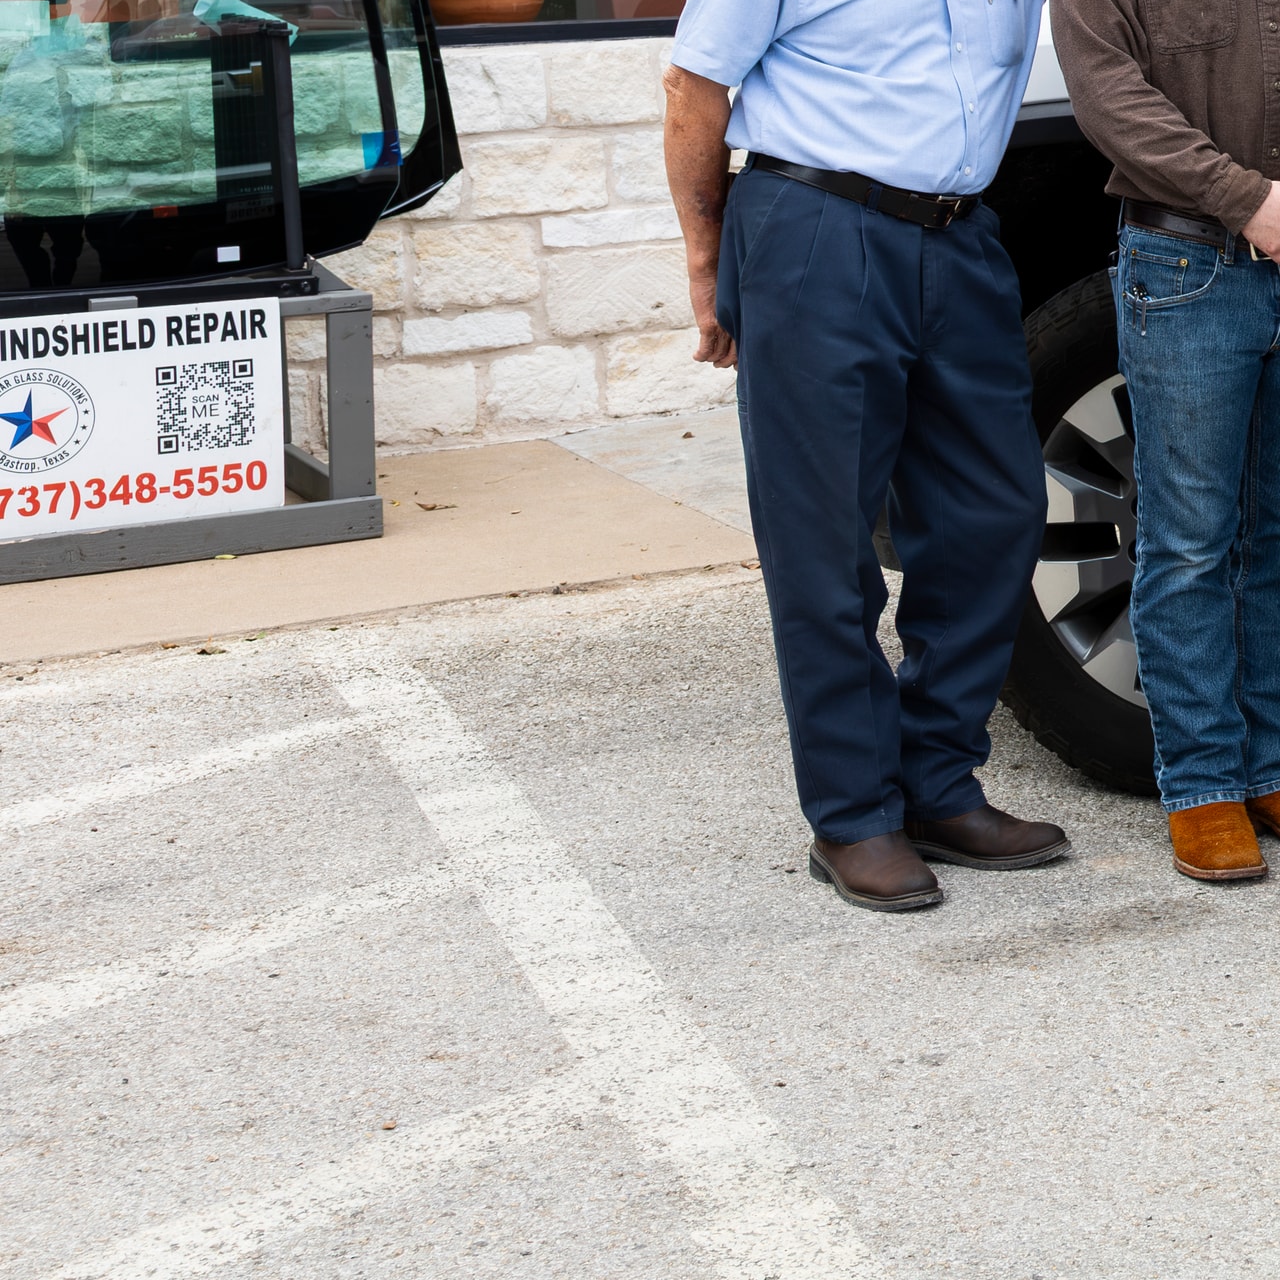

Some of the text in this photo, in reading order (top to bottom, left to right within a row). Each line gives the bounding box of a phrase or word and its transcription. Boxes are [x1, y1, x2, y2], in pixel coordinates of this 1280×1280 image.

[0, 308, 268, 362] INDSHIELD REPAIR
[13, 372, 44, 384] GLASS
[46, 373, 88, 405] SOLUTIONS
[192, 394, 220, 404] SCAN
[192, 403, 220, 419] ME
[42, 450, 70, 467] Texas
